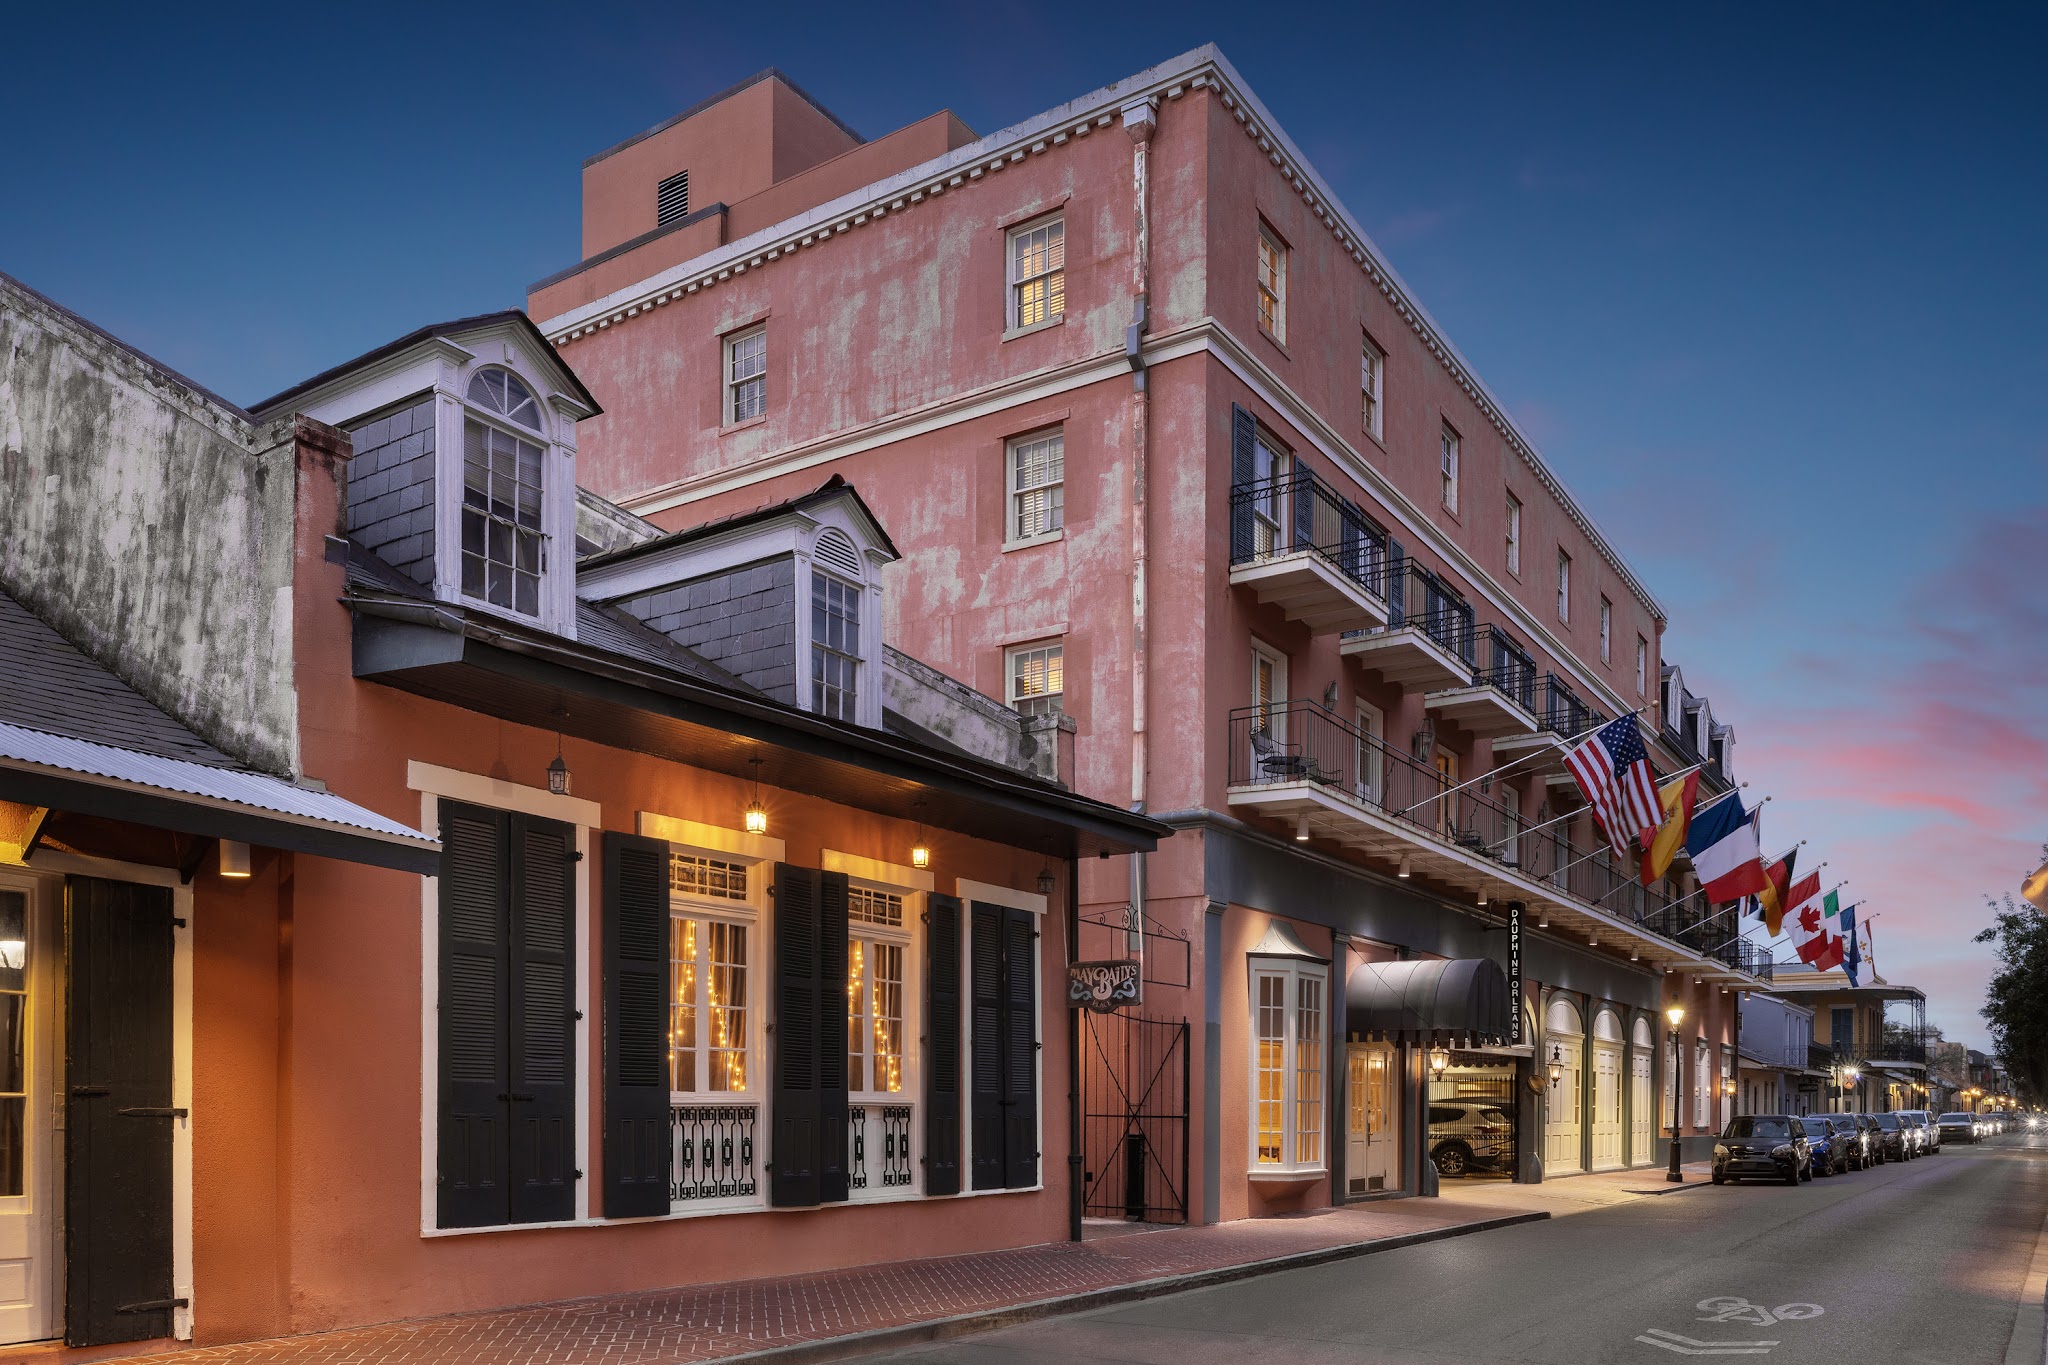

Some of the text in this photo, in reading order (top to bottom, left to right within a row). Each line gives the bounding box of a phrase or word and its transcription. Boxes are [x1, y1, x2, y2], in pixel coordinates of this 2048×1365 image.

[1070, 967, 1093, 986] MAY
[1511, 910, 1519, 1039] DAUPHINE ORLEANS
[1092, 1000, 1111, 1008] PLACE
